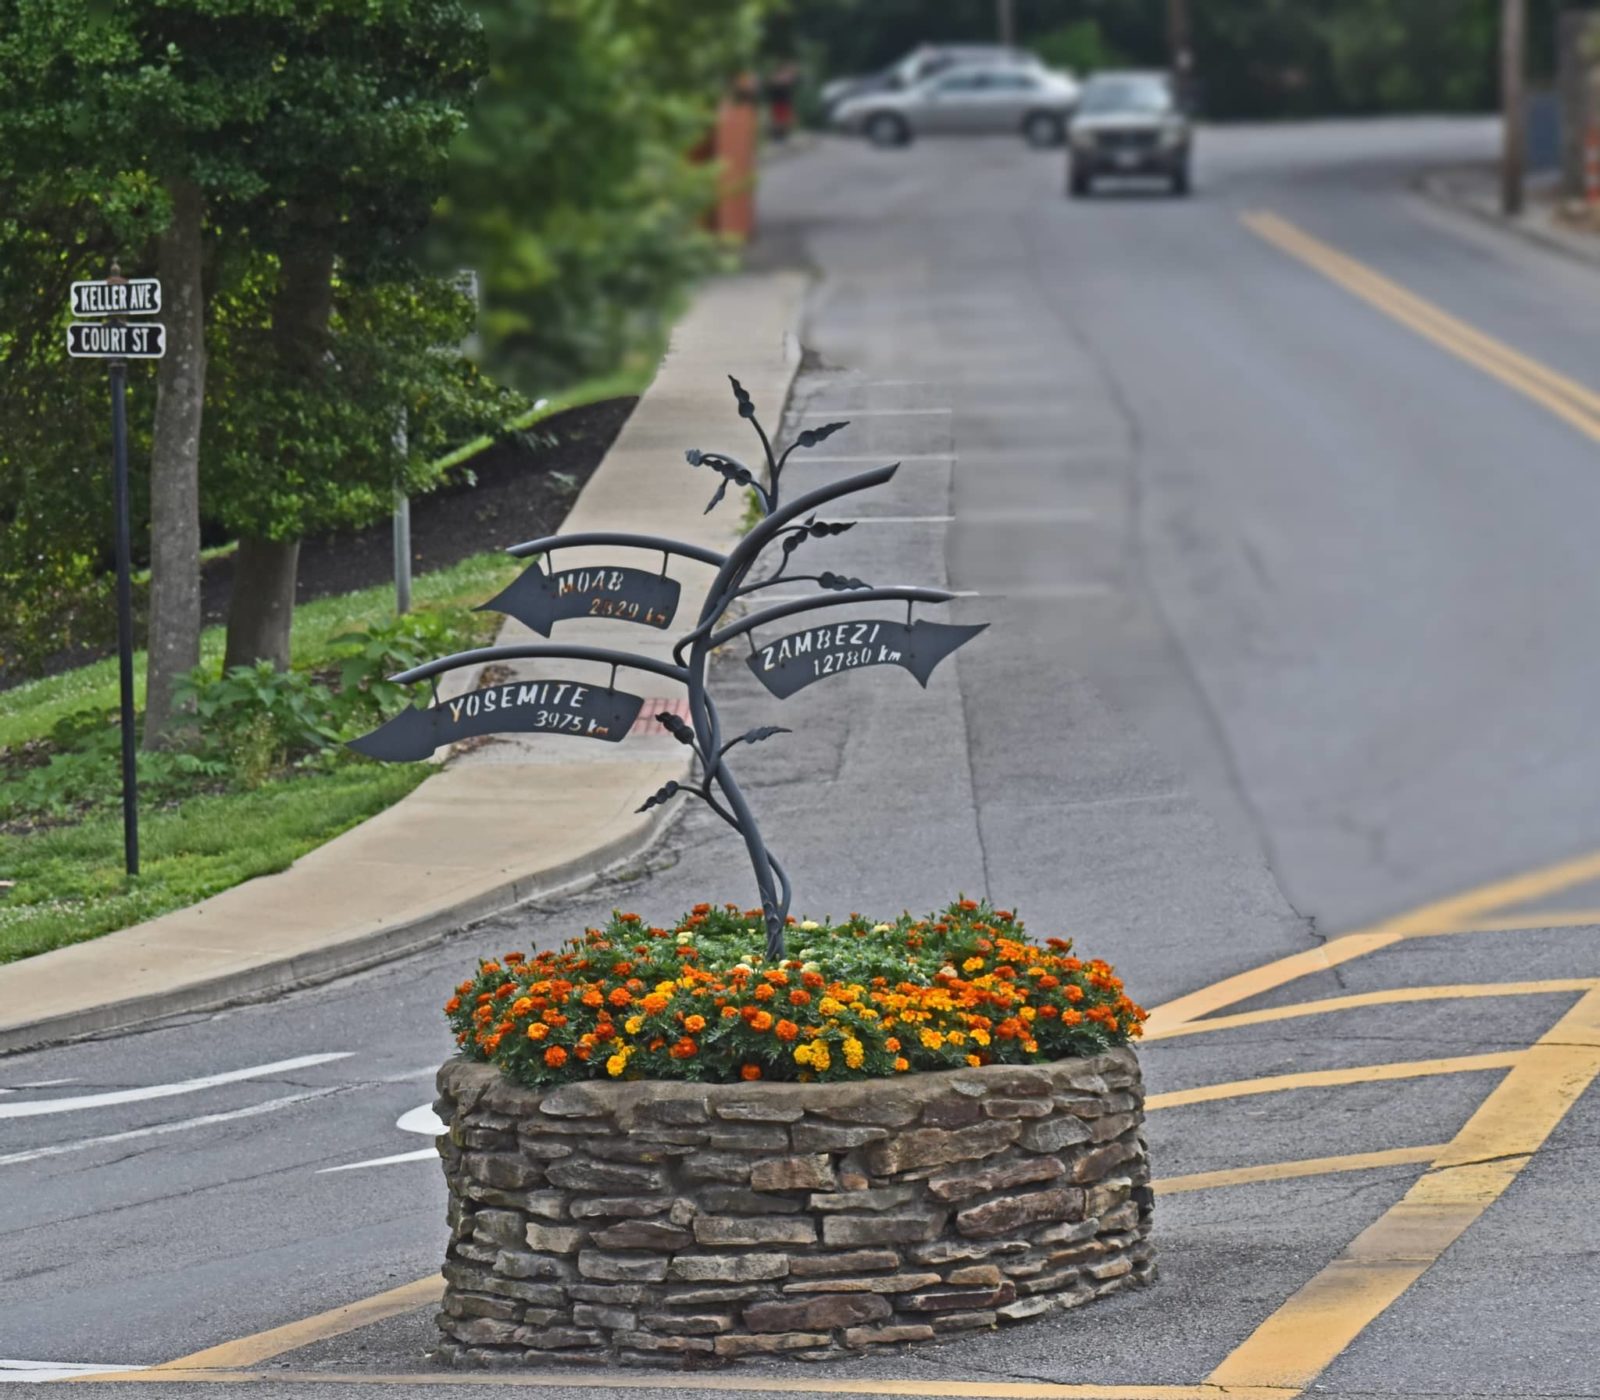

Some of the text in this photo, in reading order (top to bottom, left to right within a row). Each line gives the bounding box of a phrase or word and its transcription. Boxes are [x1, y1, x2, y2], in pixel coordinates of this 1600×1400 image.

[81, 284, 152, 311] KELLER AVE
[81, 327, 149, 352] COURT ST
[558, 570, 624, 597] MOAB
[762, 624, 880, 671] ZAMBEZI
[814, 645, 902, 676] 12780 km
[450, 683, 589, 723] YOSEMITE
[534, 710, 584, 732] 3975
